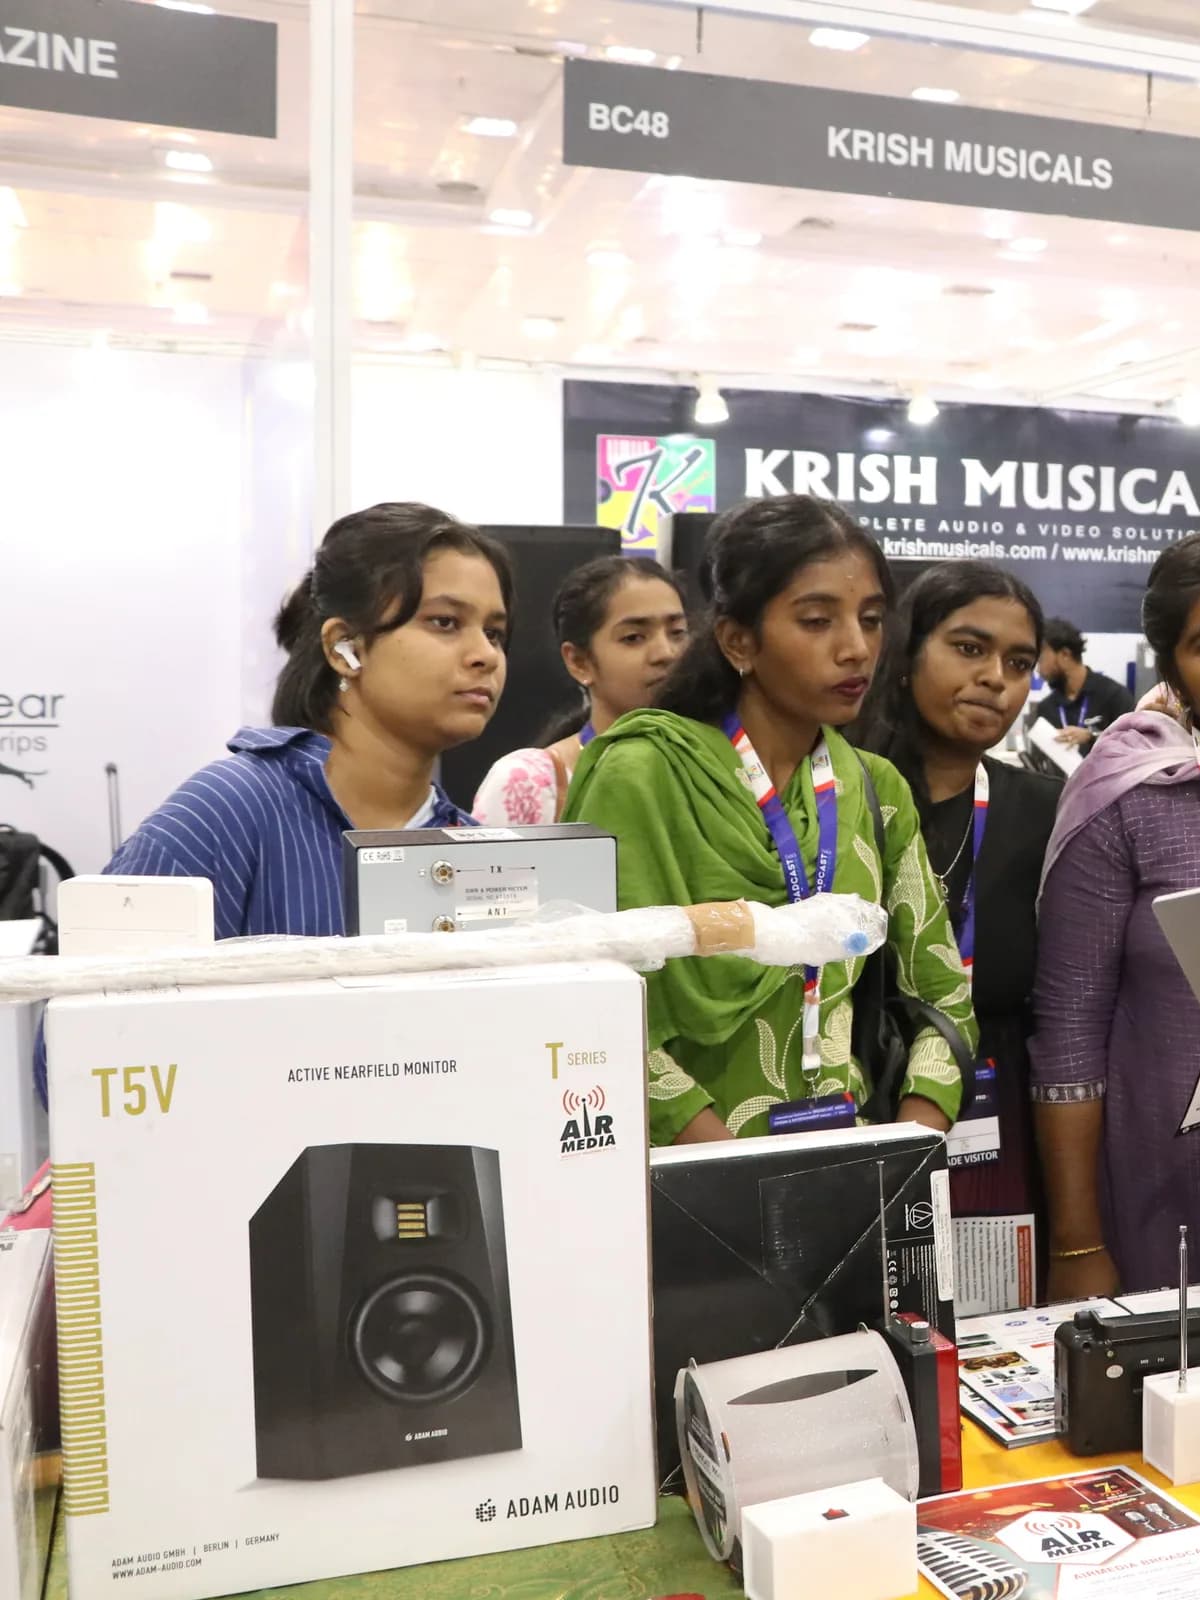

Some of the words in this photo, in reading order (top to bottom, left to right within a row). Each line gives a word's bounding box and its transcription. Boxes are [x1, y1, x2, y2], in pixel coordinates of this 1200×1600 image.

[0, 26, 119, 79] ZINE
[588, 102, 670, 138] BC48
[827, 126, 933, 168] KRISH
[945, 141, 1113, 190] MUSICALS
[744, 448, 938, 504] KRISH
[938, 519, 1004, 535] AUDIO
[1016, 521, 1026, 535] &
[1039, 524, 1101, 538] VIDEO
[287, 1067, 331, 1083] ACTIVE
[334, 1062, 400, 1080] NEARFIELD
[404, 1059, 458, 1076] MONITOR
[545, 1042, 564, 1079] T
[567, 1050, 607, 1066] SERIES
[91, 1063, 178, 1118] T5V
[560, 1107, 613, 1141] AIR
[561, 1135, 616, 1153] MEDIA
[965, 1150, 998, 1166] VISITOR
[414, 1430, 430, 1440] ADAM
[431, 1428, 448, 1438] AUDIO
[506, 1493, 558, 1519] ADAM
[564, 1485, 619, 1511] AUDIO
[112, 1557, 134, 1568] ADAM
[137, 1551, 160, 1564] AUDIO
[163, 1548, 186, 1560] GMBH
[203, 1541, 229, 1553] BERLIN
[245, 1533, 280, 1546] GERMANY
[1041, 1527, 1105, 1552] AIR
[1046, 1539, 1115, 1558] MEDIA
[112, 1558, 202, 1580] WWW.ADAM-AUDIO.COM
[1074, 1562, 1138, 1581] AIRMEDIA
